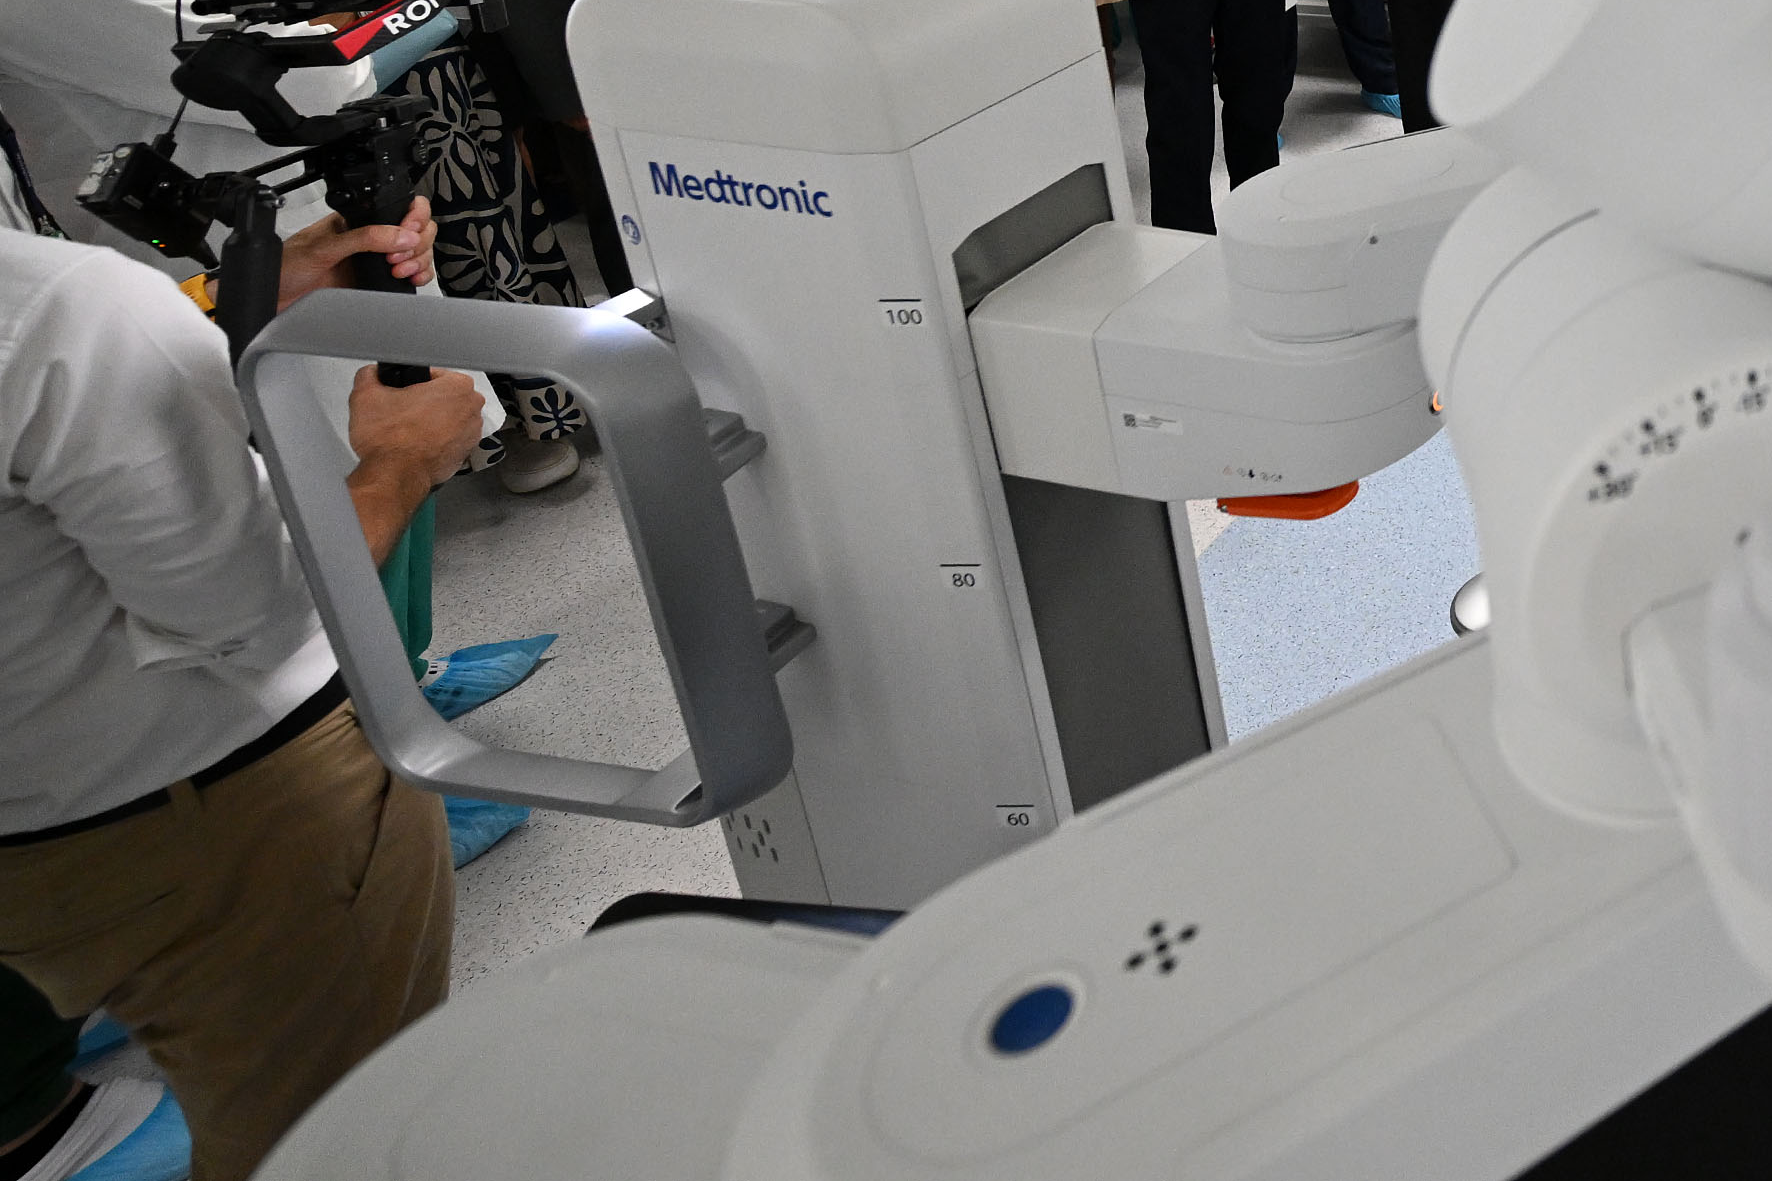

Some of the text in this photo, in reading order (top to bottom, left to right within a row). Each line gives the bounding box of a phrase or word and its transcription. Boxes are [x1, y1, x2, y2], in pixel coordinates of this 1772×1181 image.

[648, 161, 834, 218] Medtronic
[886, 309, 922, 325] 100
[952, 572, 976, 588] 80
[1007, 812, 1030, 827] 60
